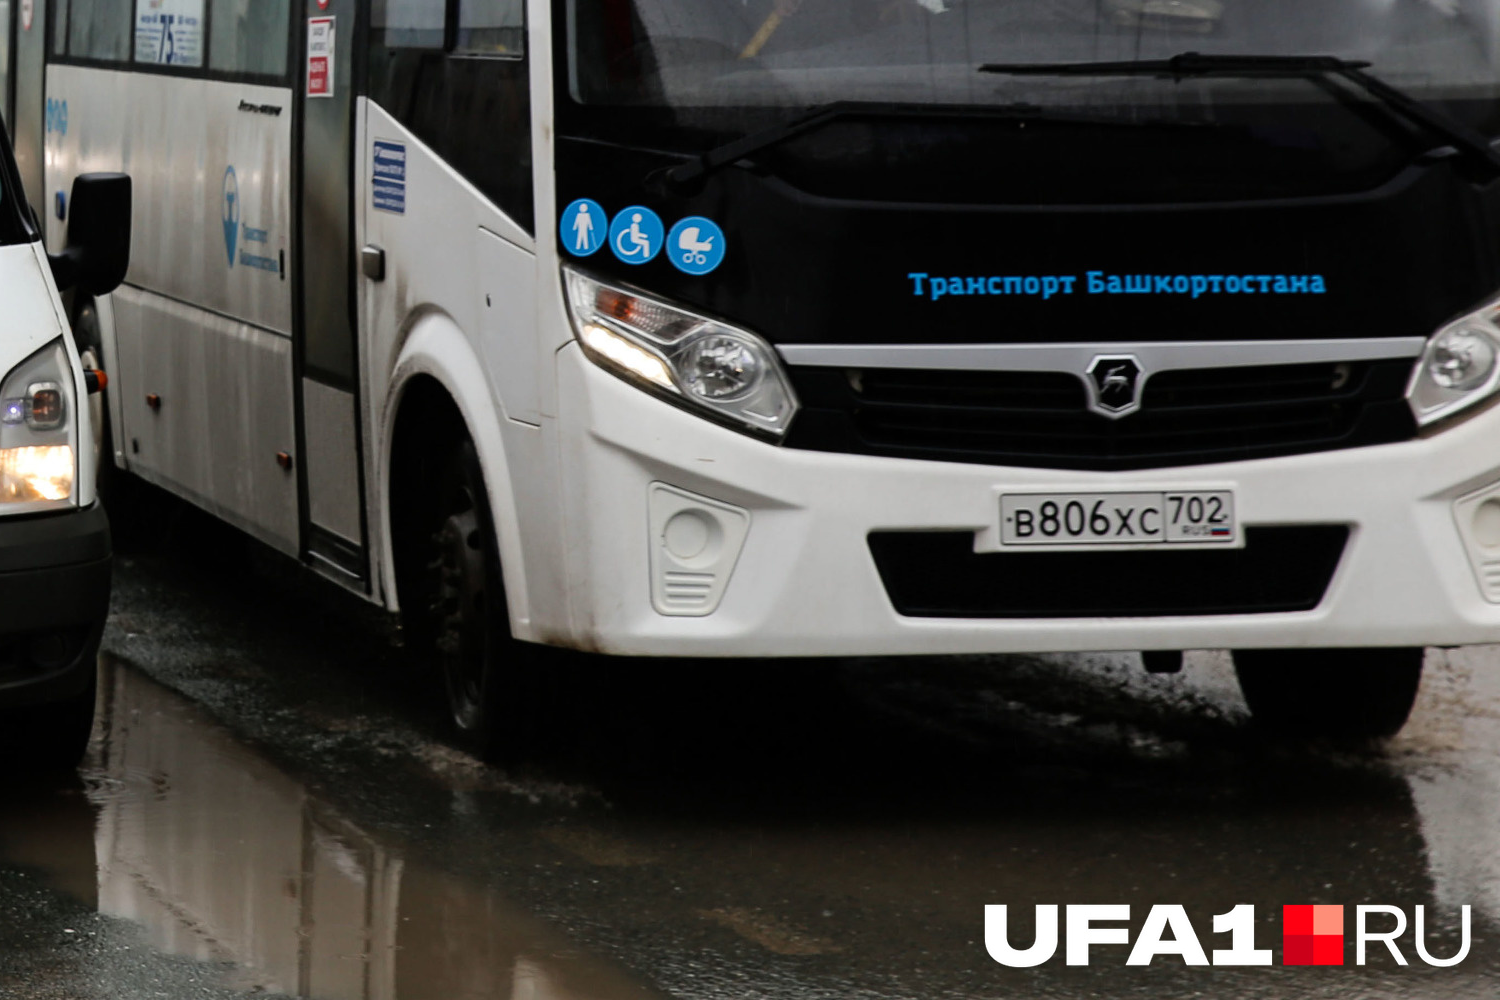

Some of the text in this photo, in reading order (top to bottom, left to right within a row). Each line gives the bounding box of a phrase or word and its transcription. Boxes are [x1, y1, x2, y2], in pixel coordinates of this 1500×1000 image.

[908, 271, 1327, 301] Транспорт Башкортостана
[1014, 496, 1224, 538] В806ХС 702
[1182, 526, 1210, 537] RUS
